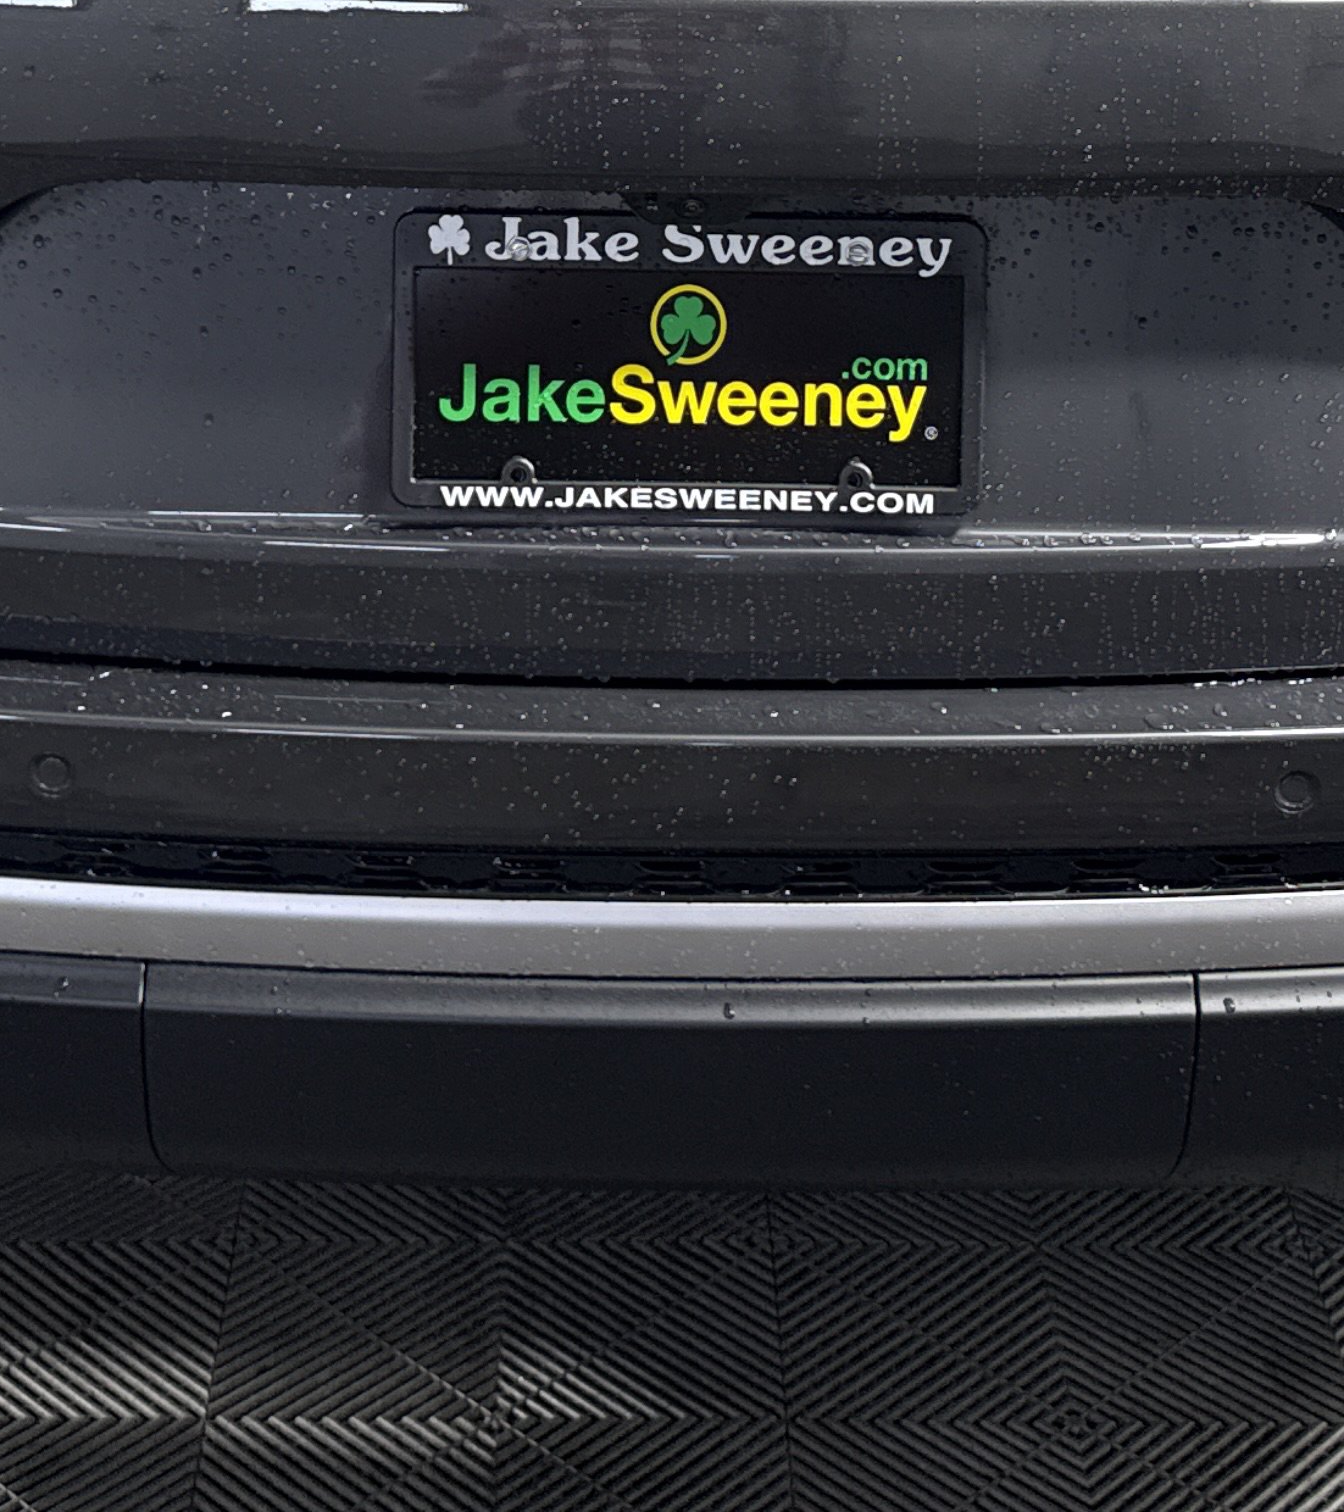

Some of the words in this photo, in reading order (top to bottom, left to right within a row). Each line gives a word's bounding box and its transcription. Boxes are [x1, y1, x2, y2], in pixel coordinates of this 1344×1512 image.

[485, 216, 640, 262] Jake
[662, 224, 952, 278] Sweeney
[842, 356, 928, 381] .com
[439, 363, 927, 442] JakeSweeney
[440, 484, 934, 515] WWW.JAKESWEENEY.COM
